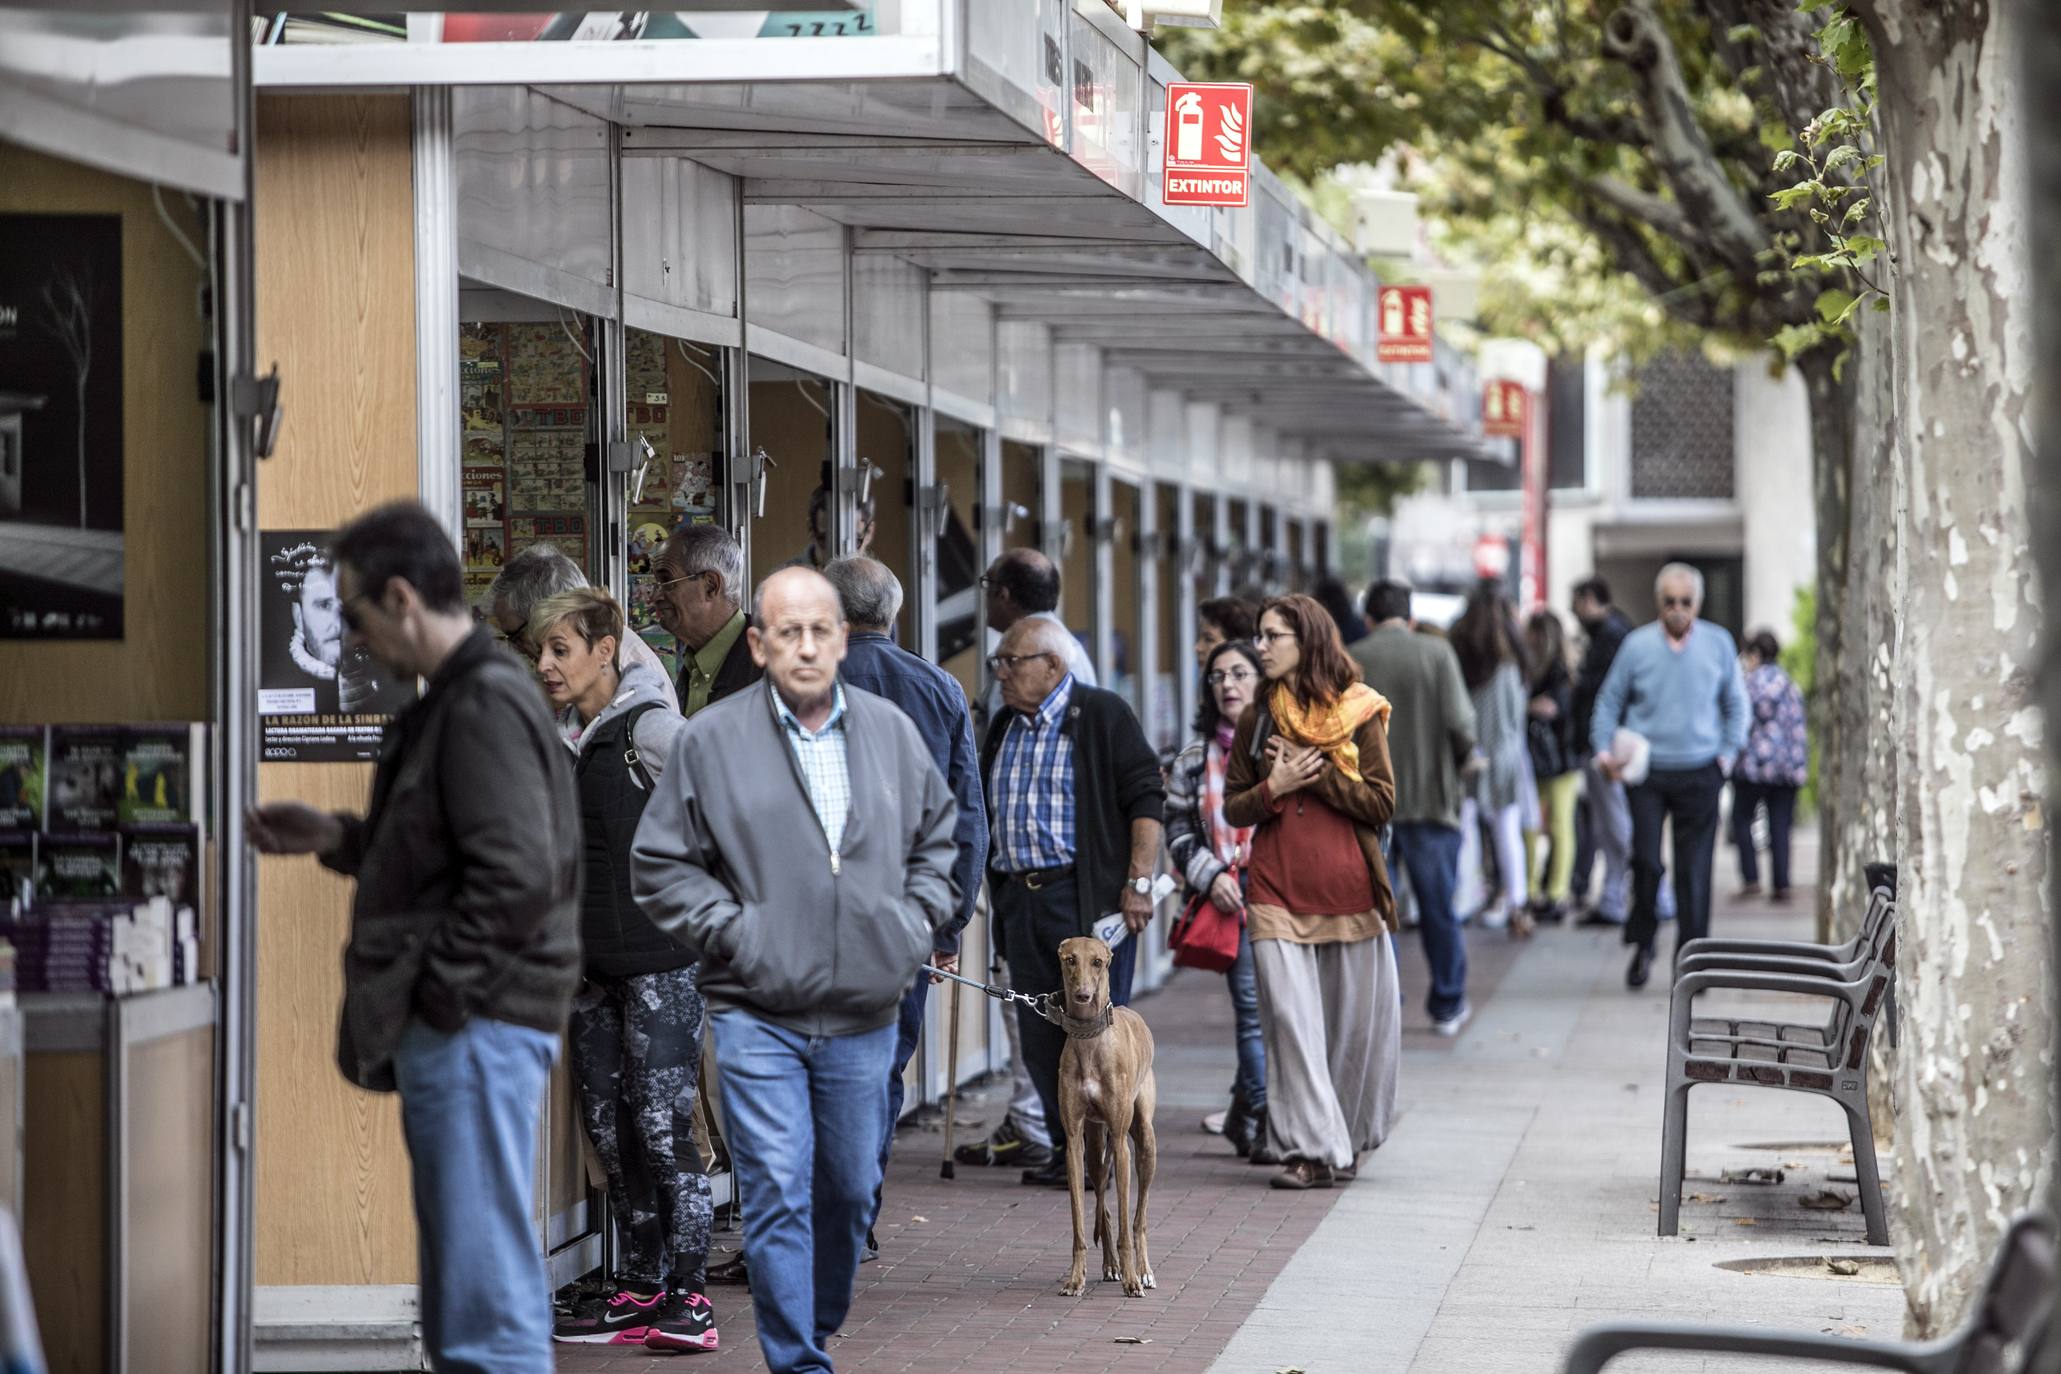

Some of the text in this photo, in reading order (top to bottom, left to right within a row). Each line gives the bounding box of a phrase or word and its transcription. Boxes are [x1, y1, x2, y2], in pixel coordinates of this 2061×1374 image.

[1168, 178, 1243, 195] EXTINTOR
[462, 468, 503, 480] ciones
[265, 715, 279, 725] LA
[321, 714, 336, 725] DE
[339, 714, 353, 724] LA
